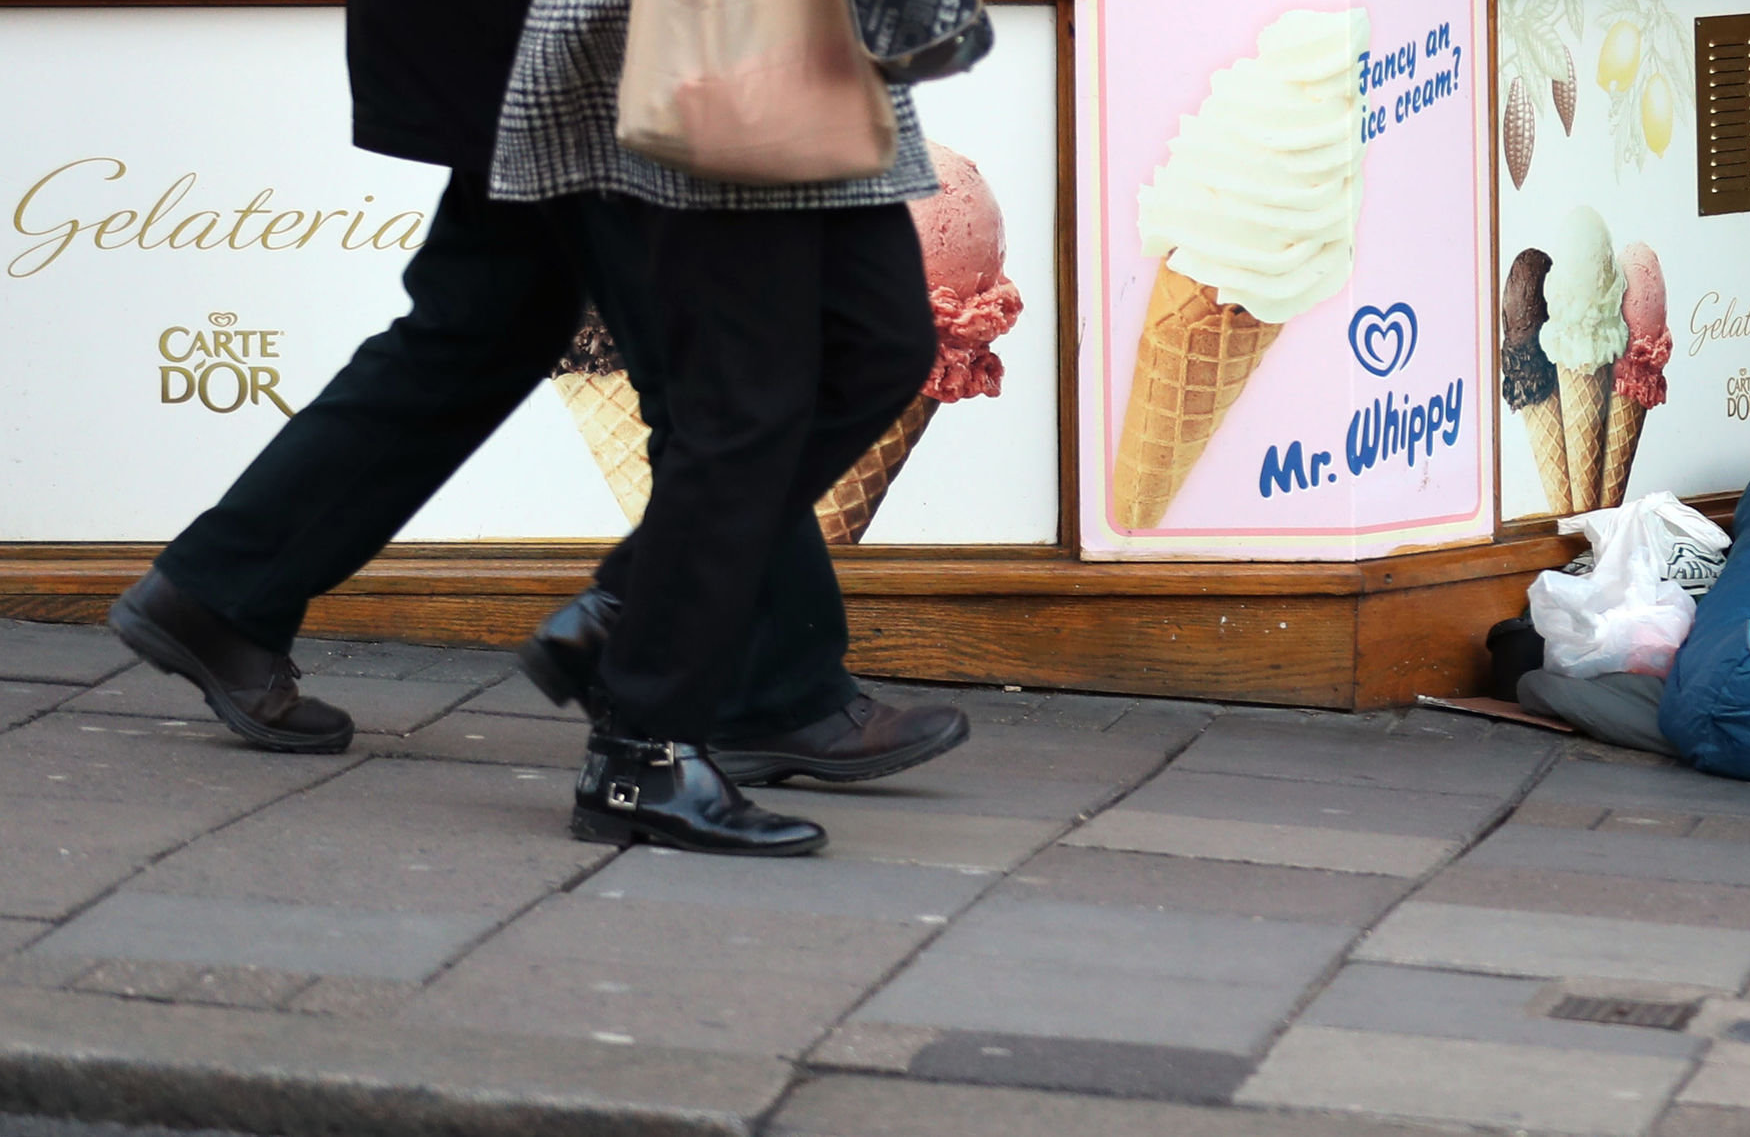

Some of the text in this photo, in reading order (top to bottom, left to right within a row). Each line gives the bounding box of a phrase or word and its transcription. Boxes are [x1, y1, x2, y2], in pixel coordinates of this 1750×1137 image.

[1358, 21, 1450, 96] Fancy an
[1361, 46, 1461, 144] ice cream?
[6, 156, 428, 278] Gelateria
[158, 325, 280, 364] CARTE
[1259, 377, 1463, 498] Mr. Whippy
